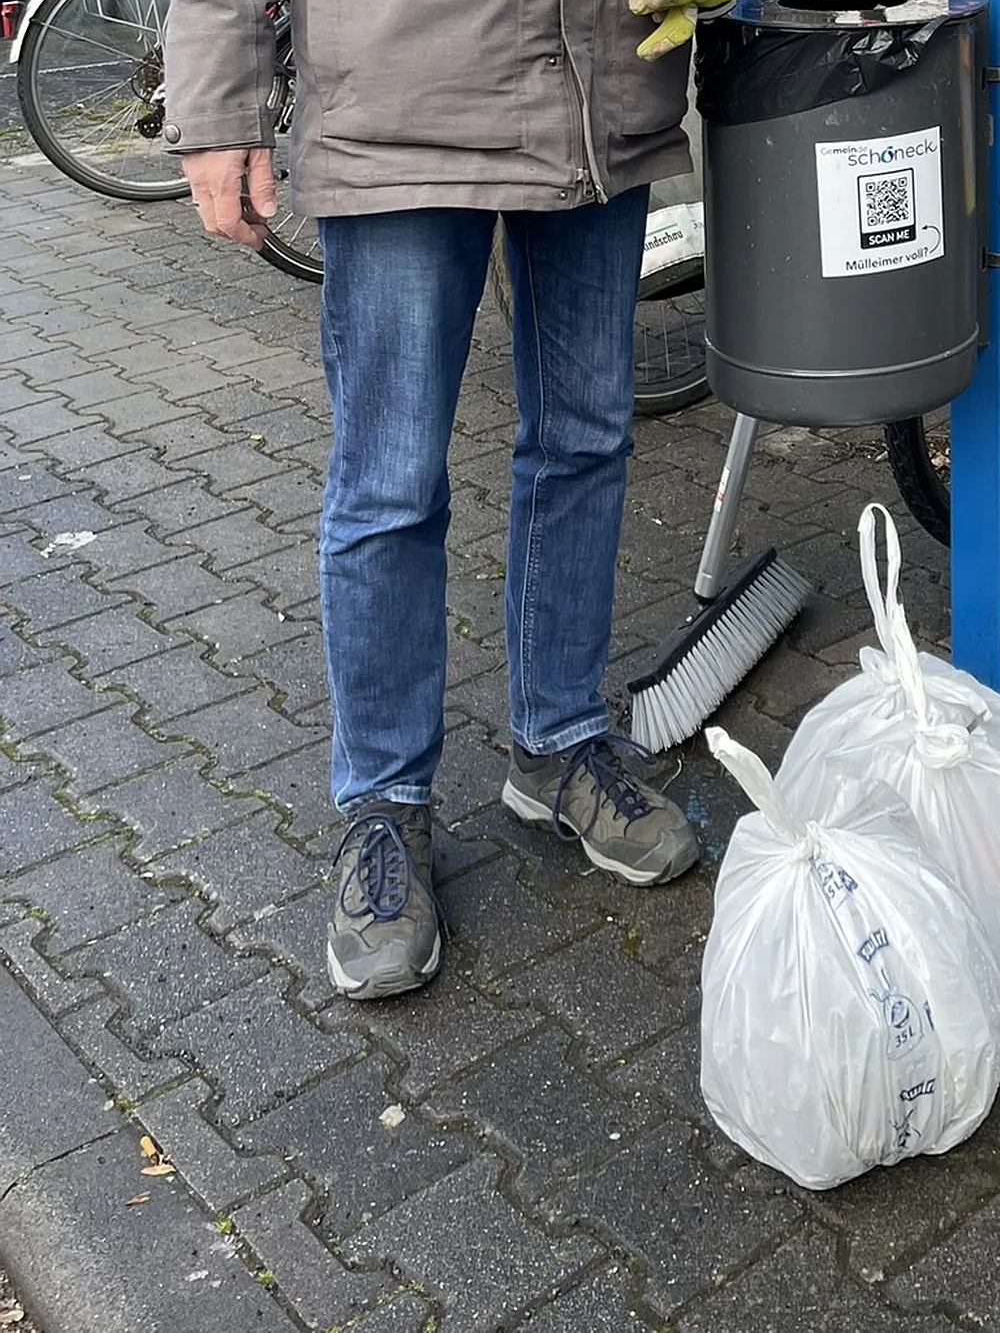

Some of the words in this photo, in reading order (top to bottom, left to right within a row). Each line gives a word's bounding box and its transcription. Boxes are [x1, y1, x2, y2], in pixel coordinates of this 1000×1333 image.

[643, 230, 684, 251] undschau
[868, 235, 894, 246] SCAN
[896, 233, 910, 242] ME
[845, 254, 903, 271] Mülleimer
[905, 246, 929, 261] voll?
